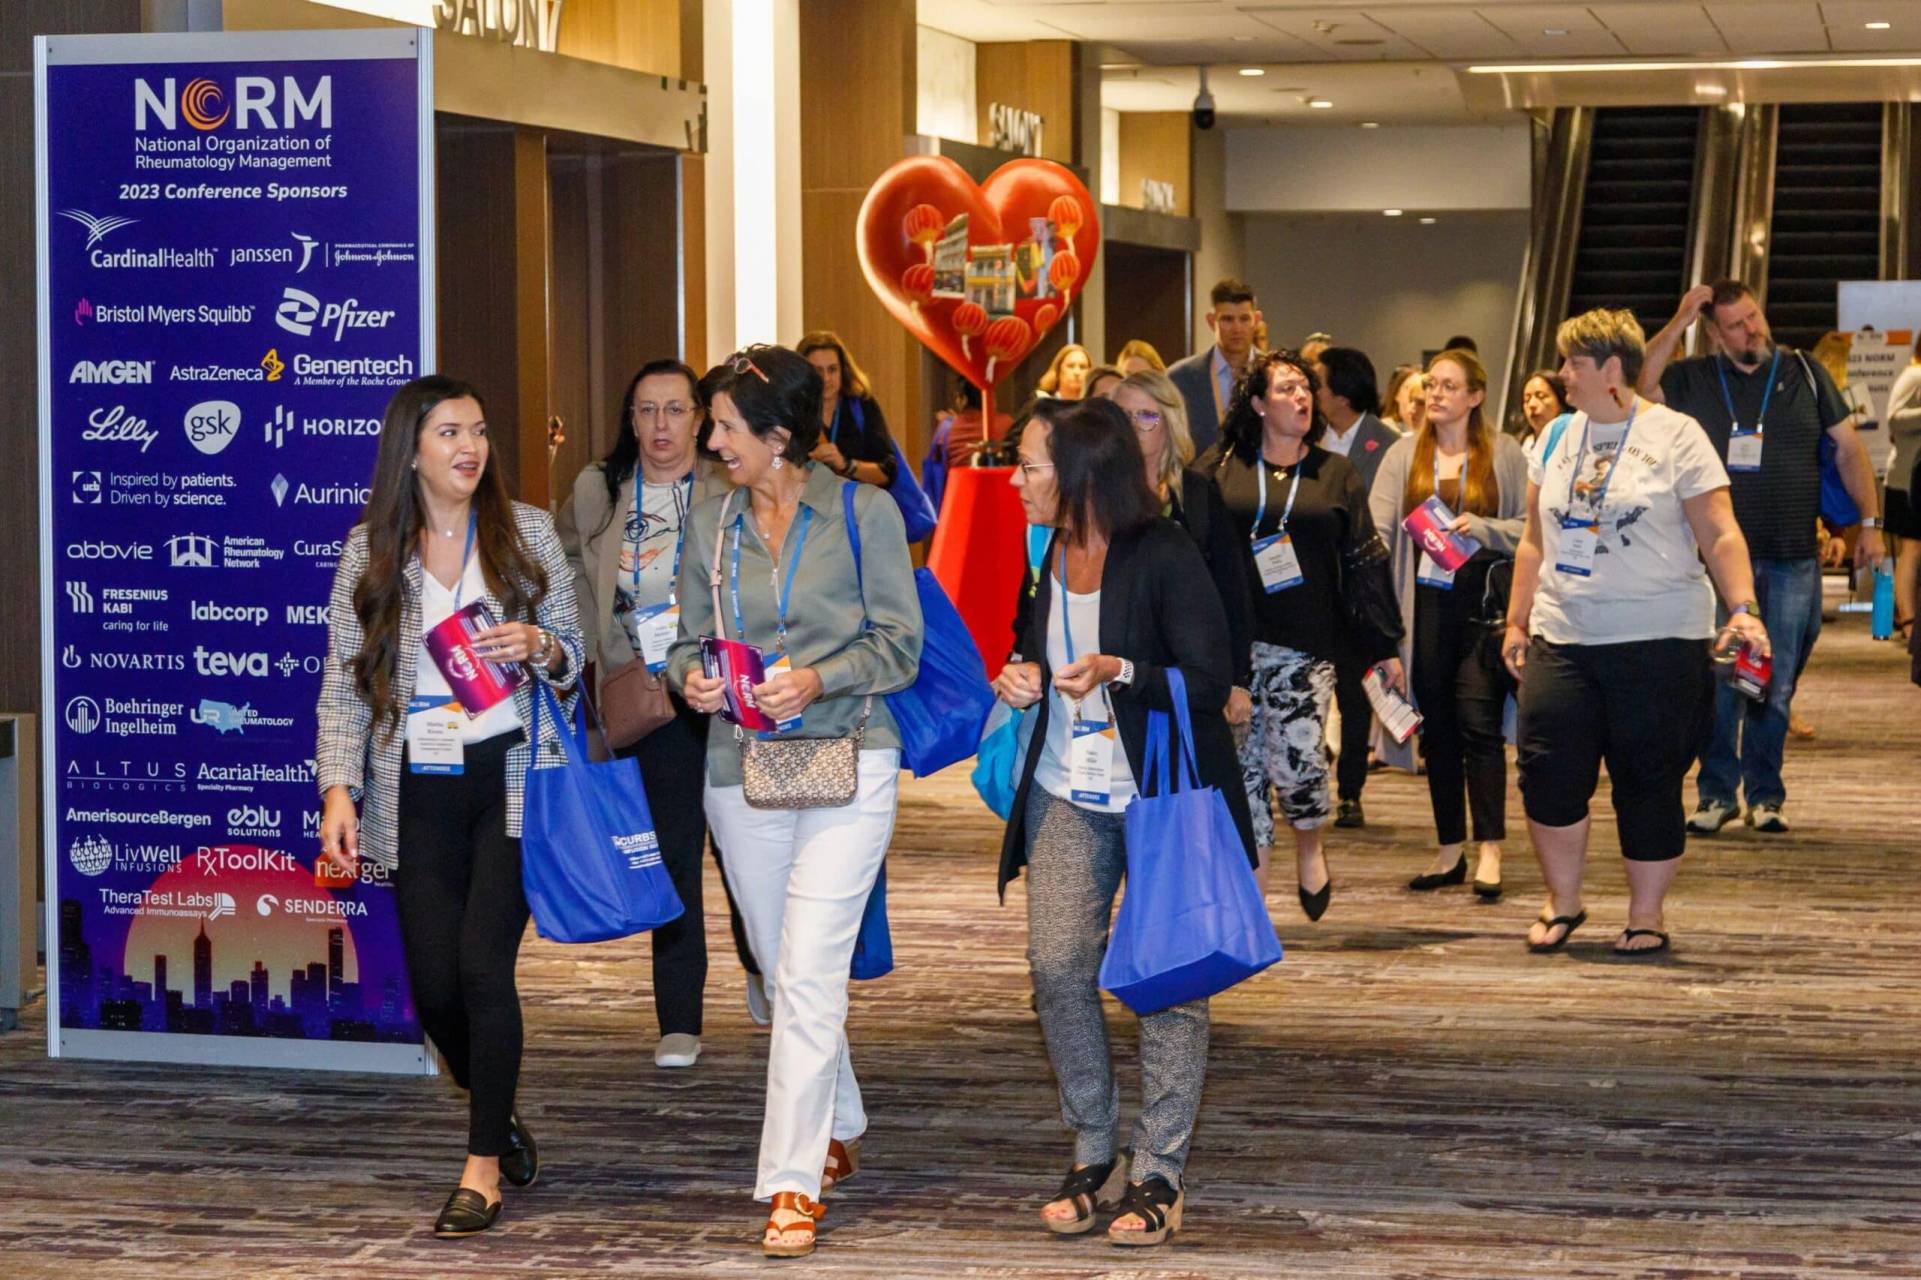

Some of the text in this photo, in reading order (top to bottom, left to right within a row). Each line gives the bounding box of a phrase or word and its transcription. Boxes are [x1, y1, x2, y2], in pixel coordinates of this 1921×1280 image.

[135, 134, 332, 154] National Organization of
[135, 154, 332, 171] Rheumatology Management
[119, 182, 348, 202] 2023 Conference Sponsors
[96, 305, 252, 326] Bristol Myers Squibb
[322, 298, 395, 342] Pfizer
[69, 360, 152, 384] AMGEN
[169, 365, 264, 382] AstraZeneca
[294, 353, 414, 376] Genentech
[294, 376, 301, 386] A
[303, 377, 335, 386] Member
[336, 376, 346, 388] of
[347, 376, 359, 386] the
[361, 376, 385, 386] Roche
[82, 404, 159, 452] Lilly
[190, 411, 233, 441] gsk
[303, 418, 383, 436] HORIZO
[82, 480, 100, 492] ucb
[110, 471, 237, 490] Inspired by patients.
[110, 489, 226, 508] Driven by science.
[67, 541, 153, 560] abbvie
[224, 536, 265, 546] American
[293, 540, 343, 556] CuraS
[224, 547, 284, 560] Rheumatology
[224, 558, 260, 568] Network
[103, 588, 168, 600] FRESENIUS
[103, 602, 133, 614] KABI
[191, 600, 269, 626] labcorp
[103, 620, 168, 632] caring for life
[90, 653, 185, 670] NOVARTIS
[193, 645, 269, 677] teva
[105, 698, 184, 718] Boehringer
[105, 718, 177, 737] Ingelheim
[197, 762, 310, 782] AcariaHealth
[197, 783, 254, 793] Specialty Pharmacy
[66, 807, 211, 829] AmerisourceBergen
[227, 804, 281, 828] eblu
[115, 843, 182, 863] LivWell
[115, 861, 182, 874] INFUSIONS
[99, 888, 173, 905] TheraTest
[104, 905, 208, 919] Advanced Immunoassays
[285, 899, 368, 917] SENDERRA
